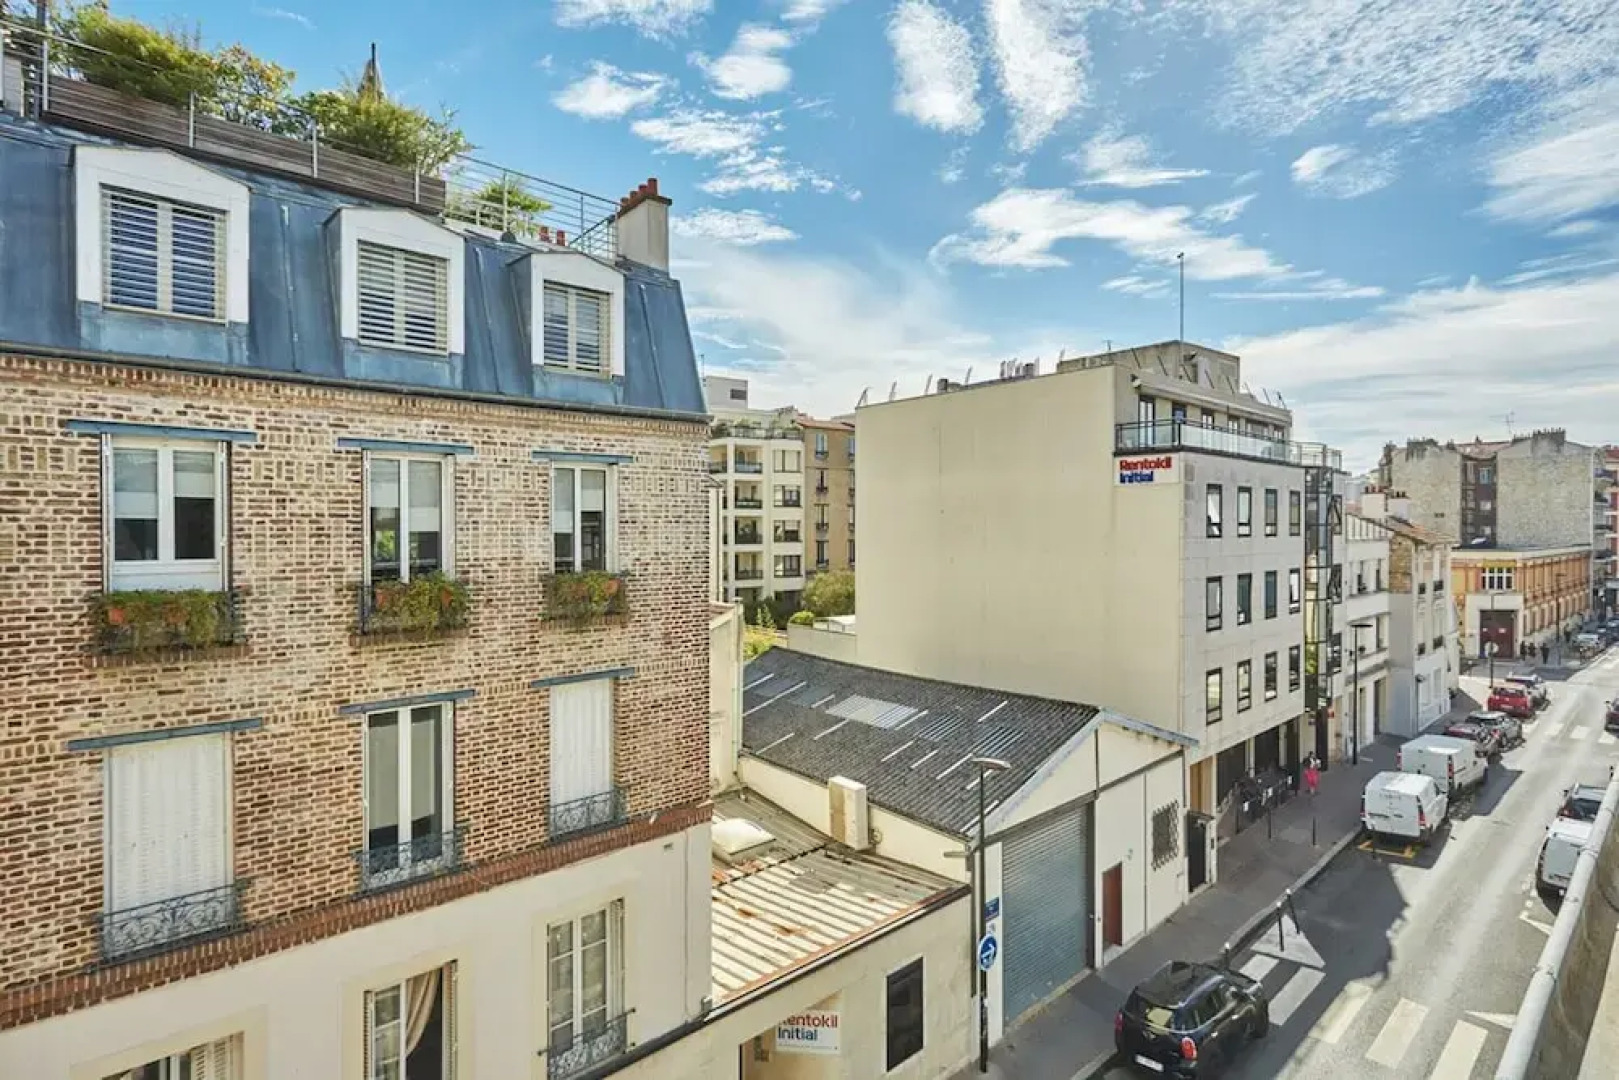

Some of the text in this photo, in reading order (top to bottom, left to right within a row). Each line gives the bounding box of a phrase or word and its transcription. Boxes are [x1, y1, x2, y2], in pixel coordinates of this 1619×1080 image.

[1119, 456, 1171, 470] Rentokil
[779, 1014, 838, 1028] entokil
[778, 1026, 818, 1041] Initial
